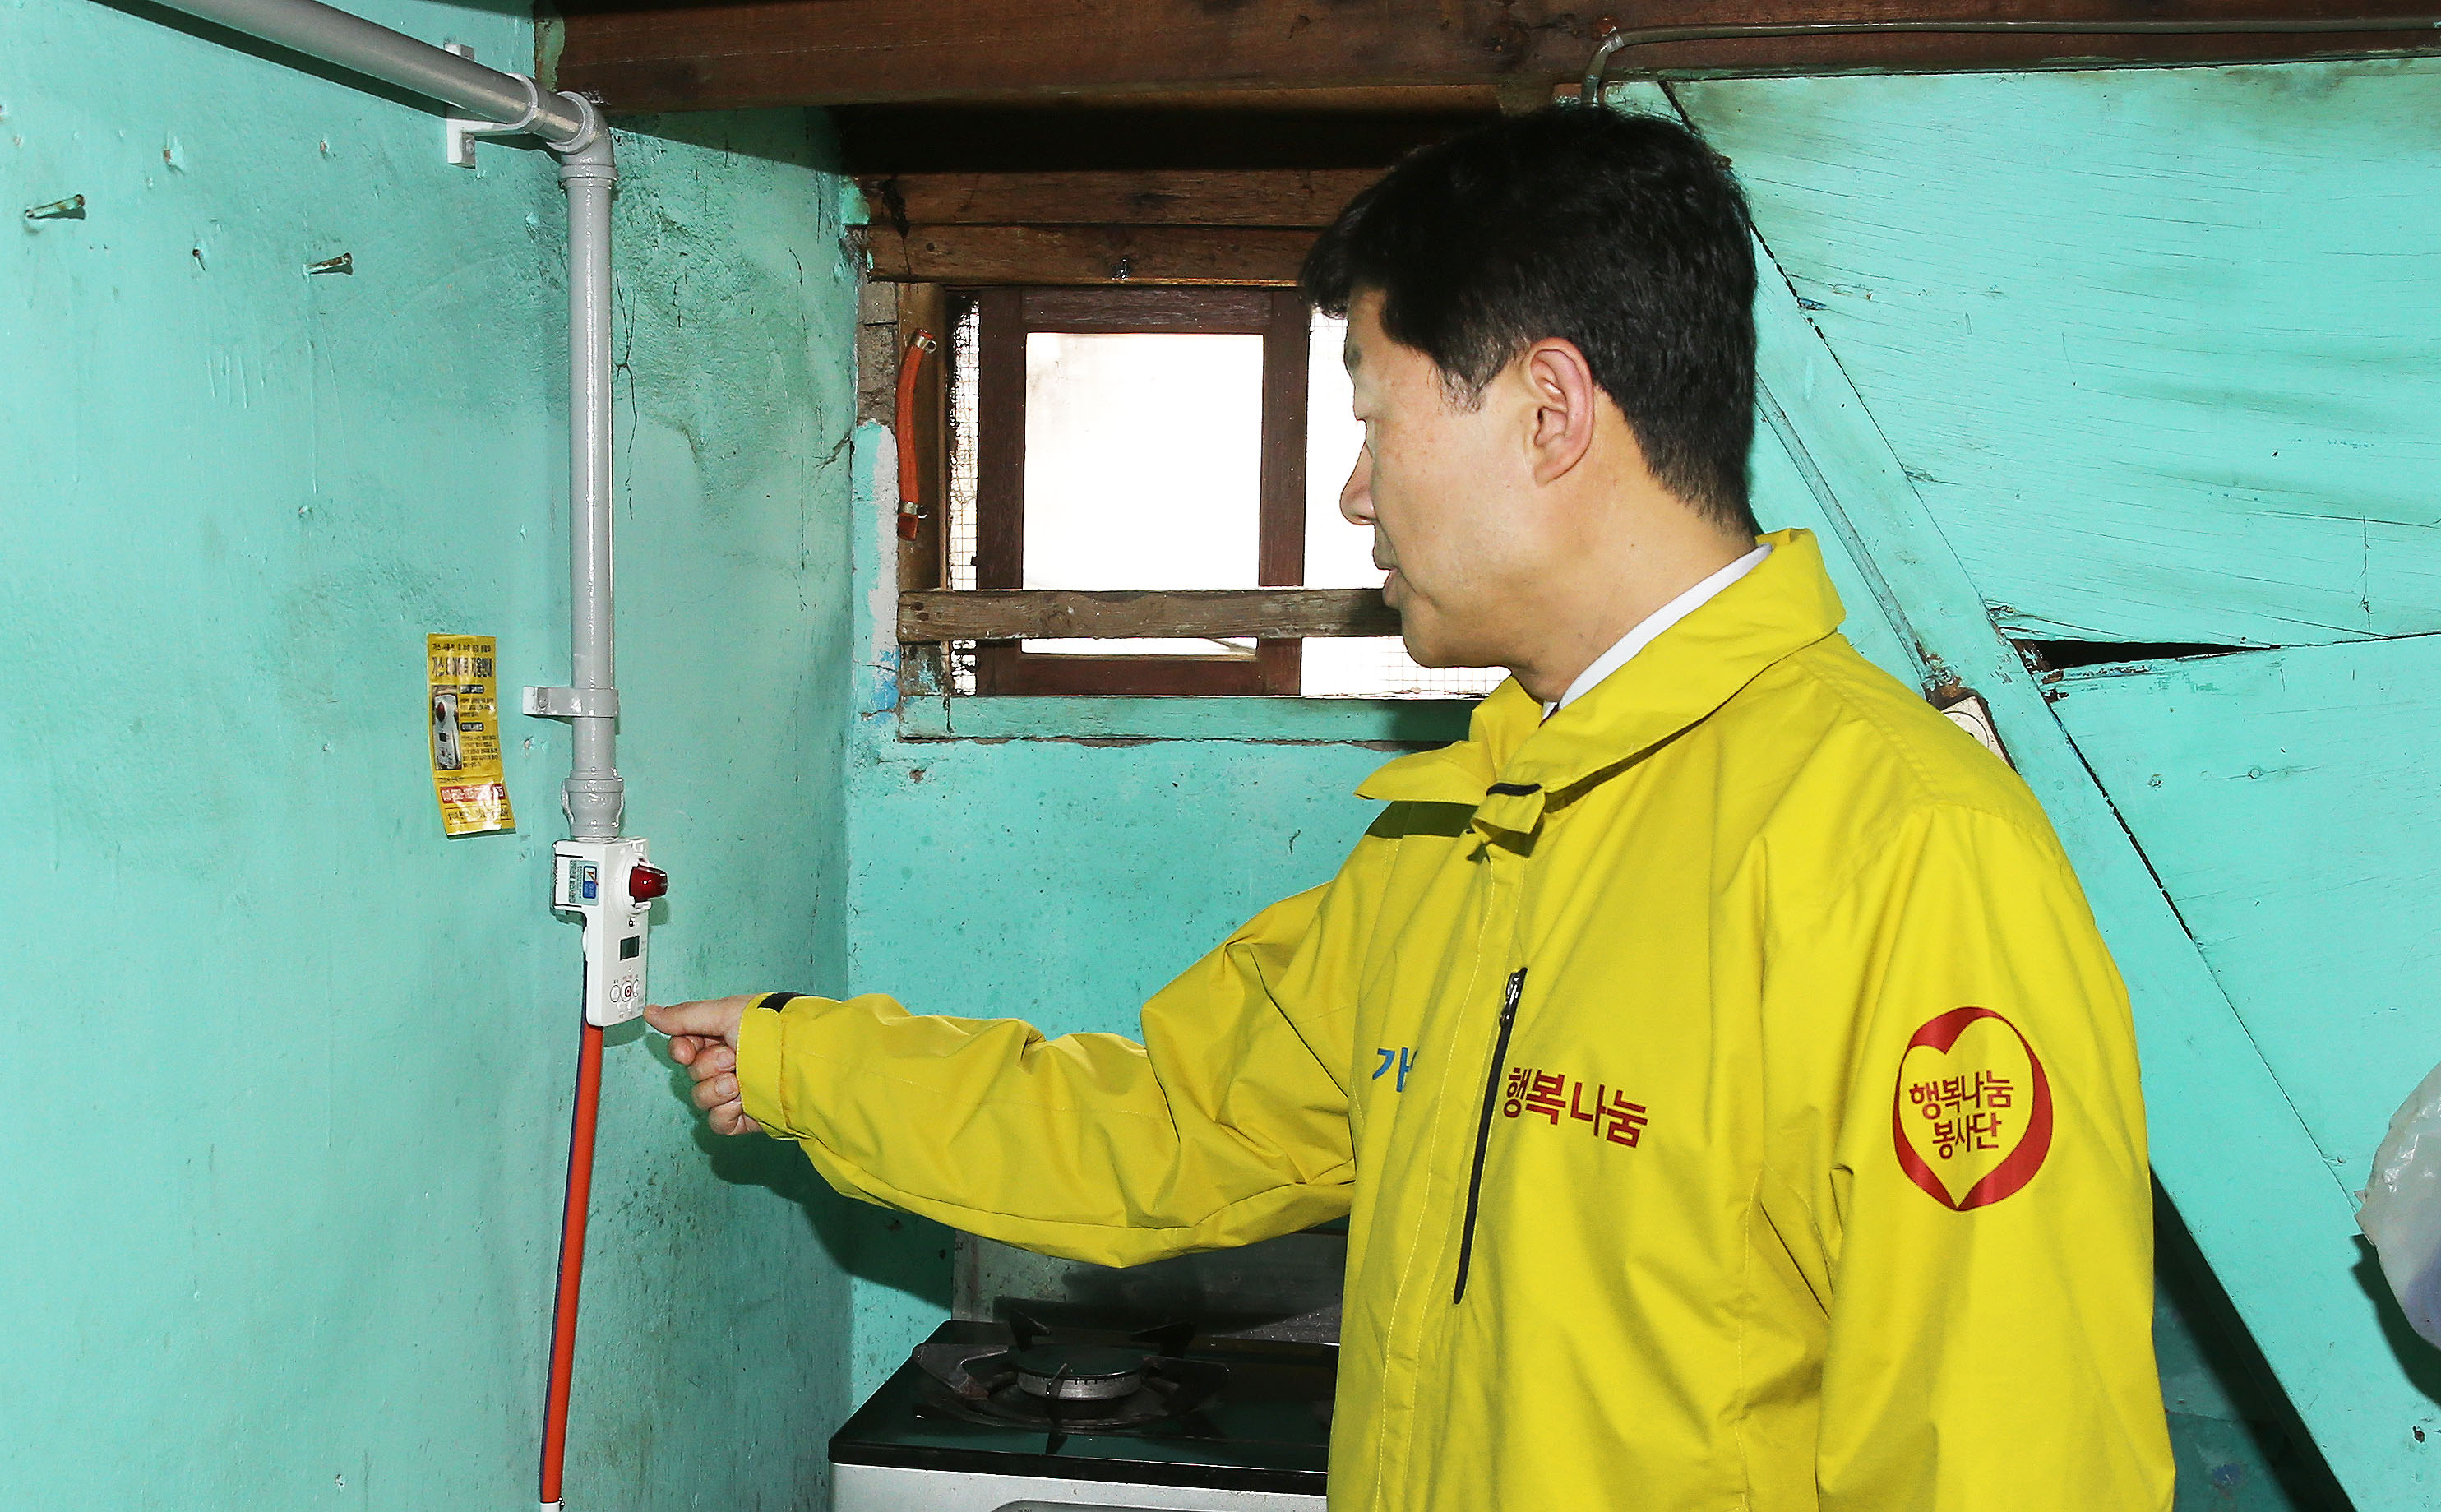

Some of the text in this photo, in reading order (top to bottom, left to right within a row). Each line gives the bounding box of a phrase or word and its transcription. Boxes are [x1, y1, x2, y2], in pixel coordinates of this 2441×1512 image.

[1504, 1067, 1648, 1148] 행복나눔
[1909, 1070, 2014, 1120] 행복나눔
[1932, 1112, 2002, 1159] 봉사단
